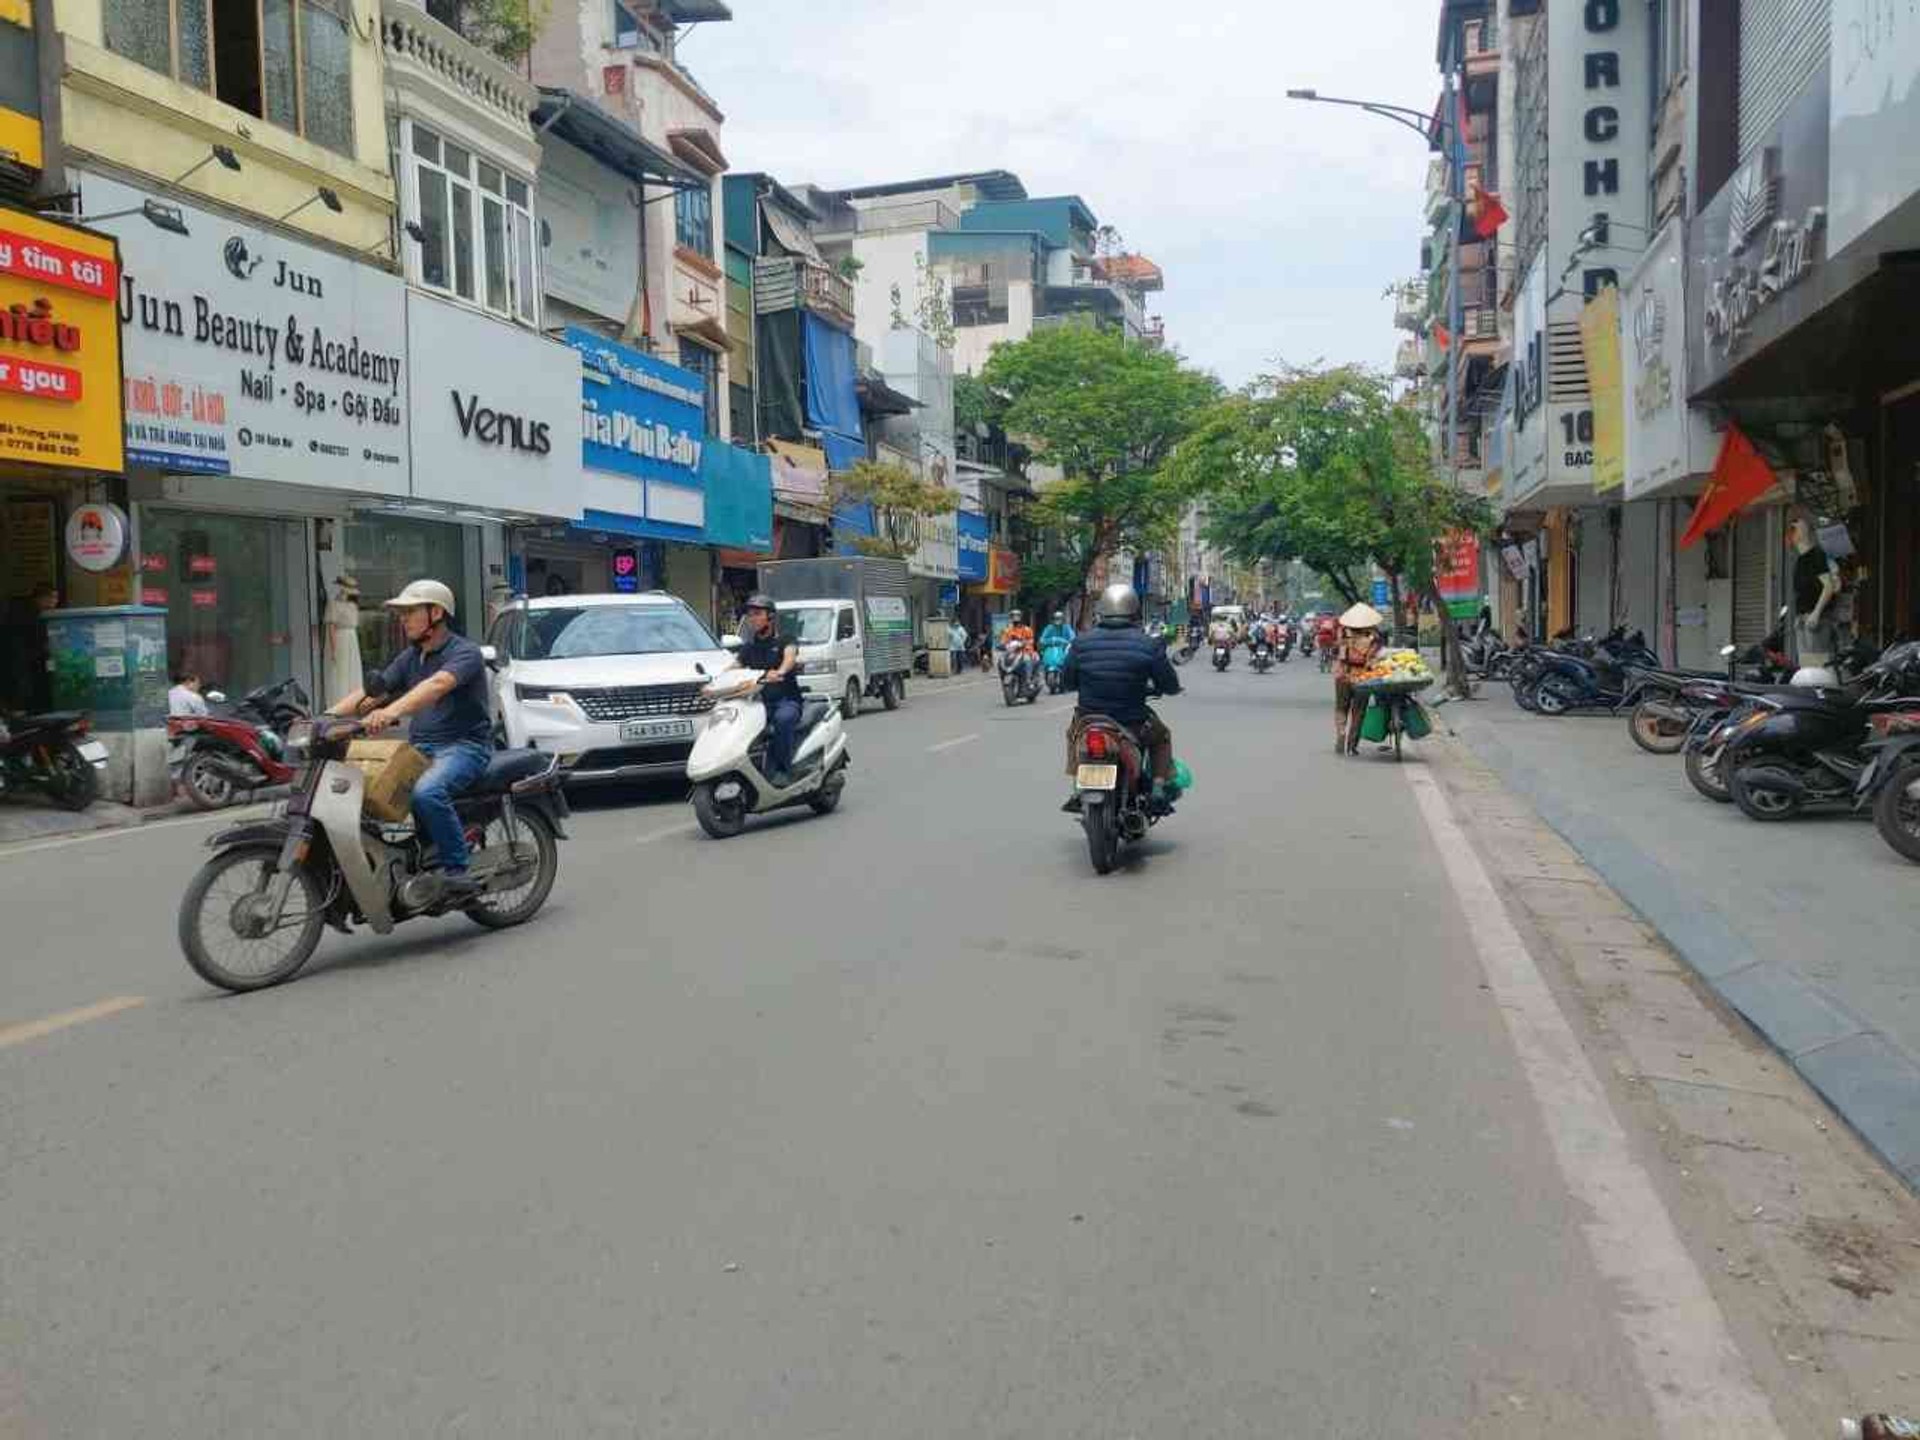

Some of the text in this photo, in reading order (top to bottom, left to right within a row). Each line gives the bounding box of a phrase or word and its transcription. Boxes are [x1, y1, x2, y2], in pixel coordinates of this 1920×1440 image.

[21, 245, 63, 276] tìm
[70, 259, 104, 288] tôi
[274, 260, 324, 298] Jun
[120, 275, 400, 397] Jun Beauty & Academy
[19, 366, 66, 392] you
[240, 369, 273, 402] Nail
[294, 381, 326, 415] Spa
[342, 391, 369, 426] Gội
[451, 389, 551, 455] Venus
